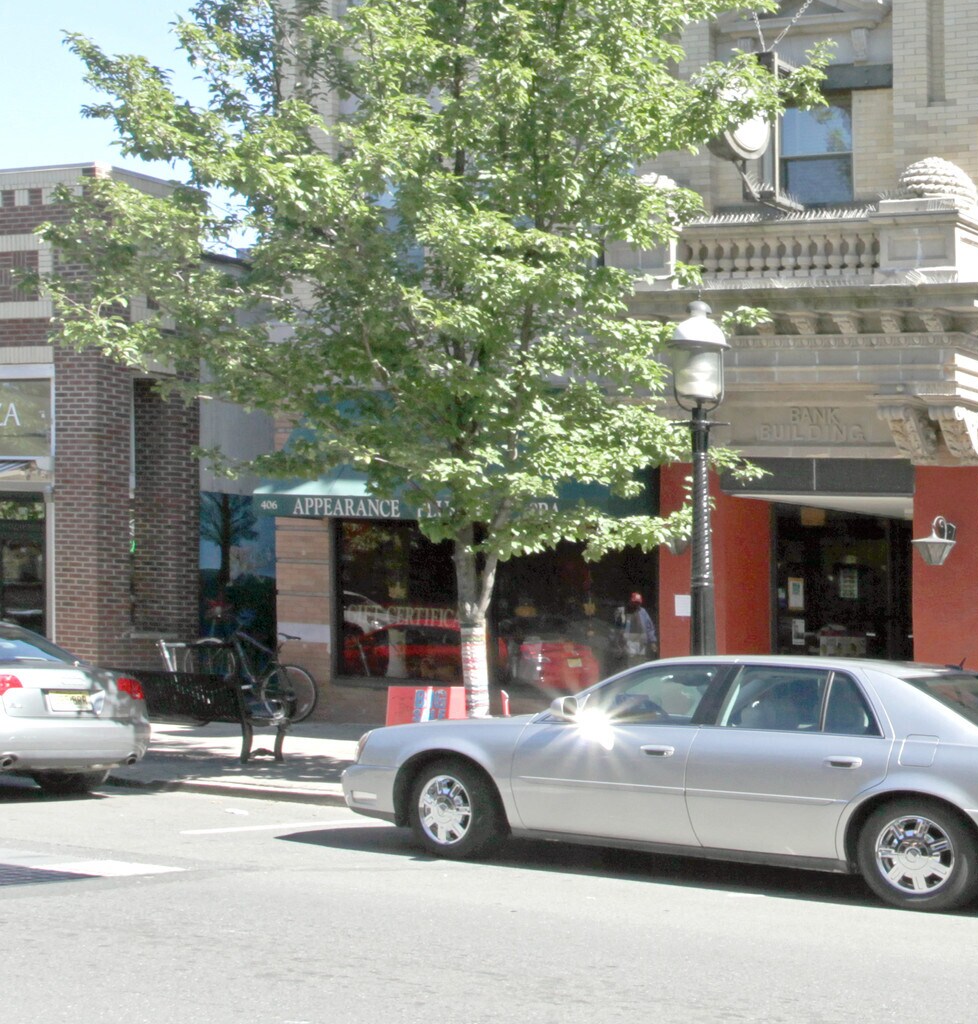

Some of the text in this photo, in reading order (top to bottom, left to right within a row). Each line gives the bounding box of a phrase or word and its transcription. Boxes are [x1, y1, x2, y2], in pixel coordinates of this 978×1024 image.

[0, 402, 21, 426] A
[790, 406, 840, 425] BANK
[757, 423, 866, 441] BUILDING
[260, 500, 278, 510] 406
[292, 497, 401, 518] APPEARANCE
